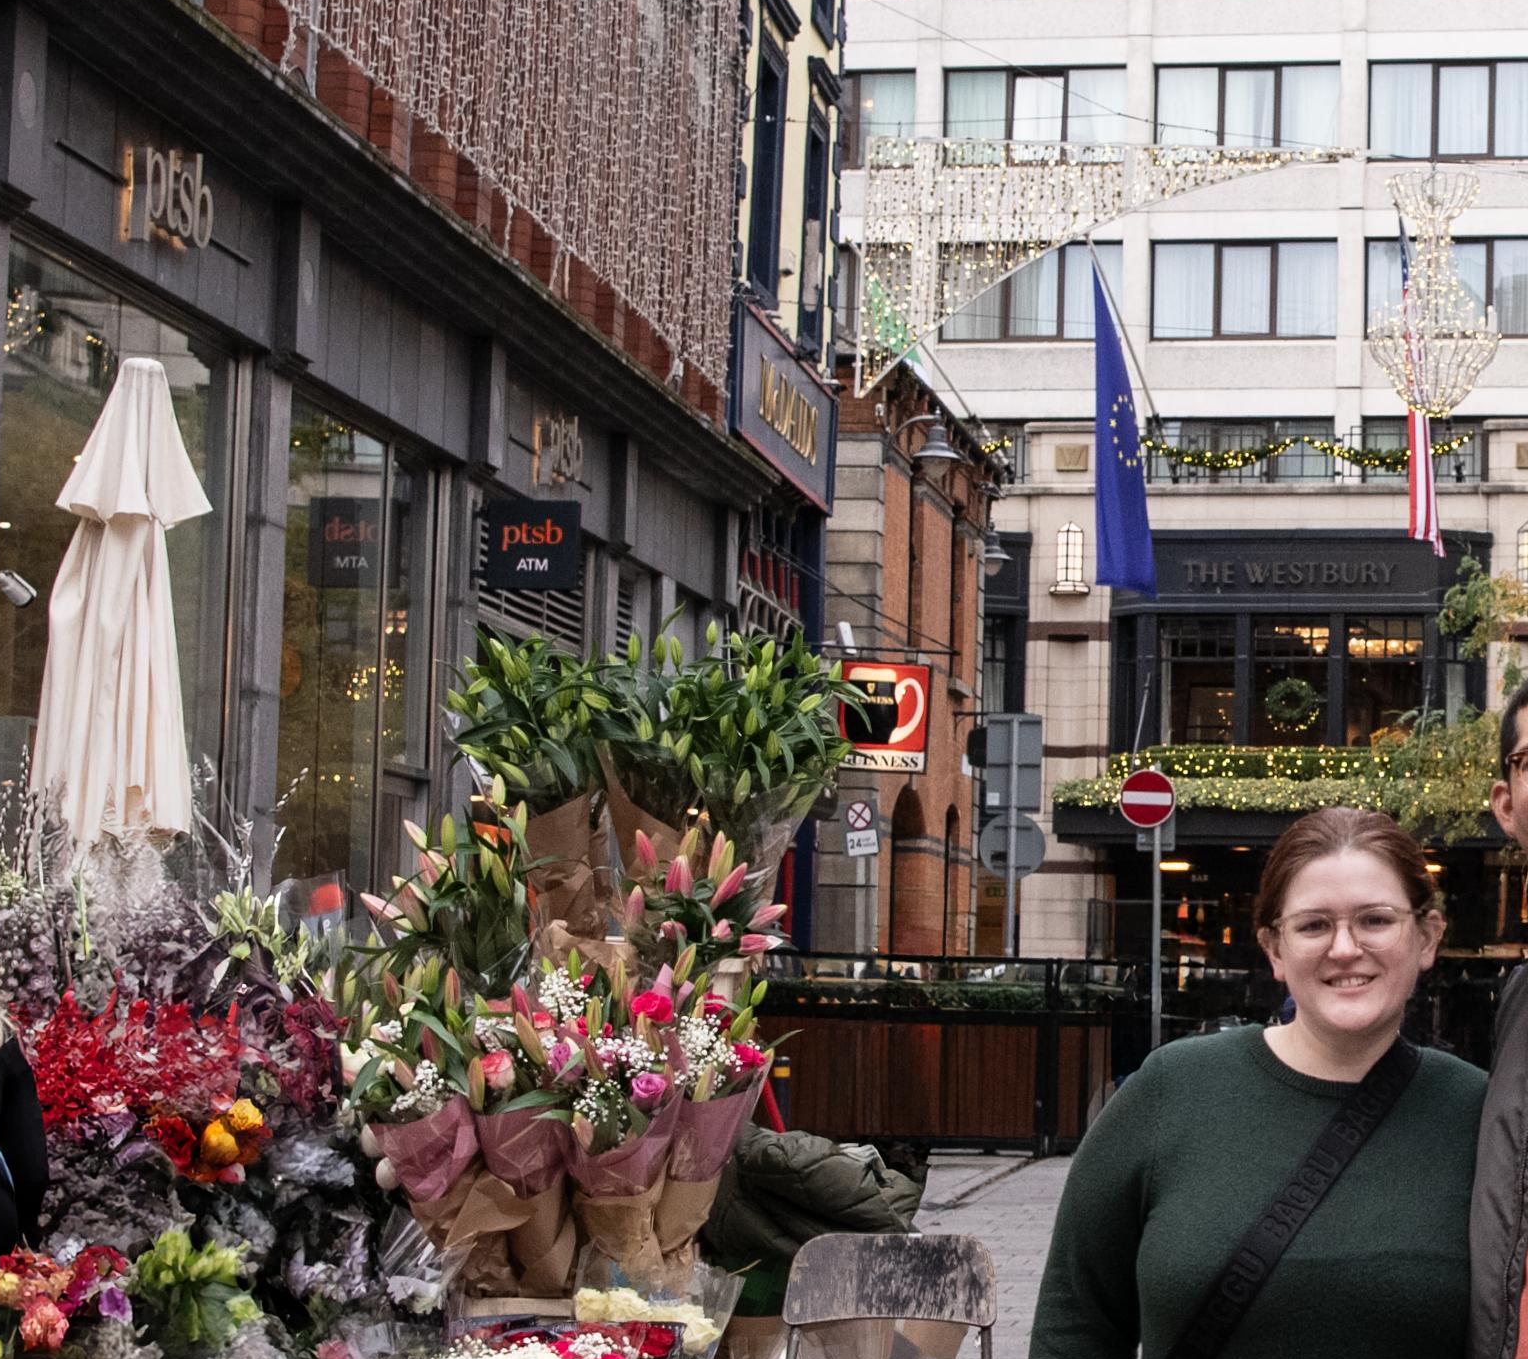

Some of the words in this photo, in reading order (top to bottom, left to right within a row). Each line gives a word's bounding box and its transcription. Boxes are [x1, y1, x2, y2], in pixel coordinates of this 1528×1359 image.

[143, 146, 214, 249] ptsb
[550, 415, 584, 481] ptsb
[501, 518, 563, 552] ptsb
[516, 558, 549, 572] ATM
[1183, 561, 1235, 584] THE
[1244, 561, 1399, 585] WESTBURY
[848, 838, 862, 849] 24
